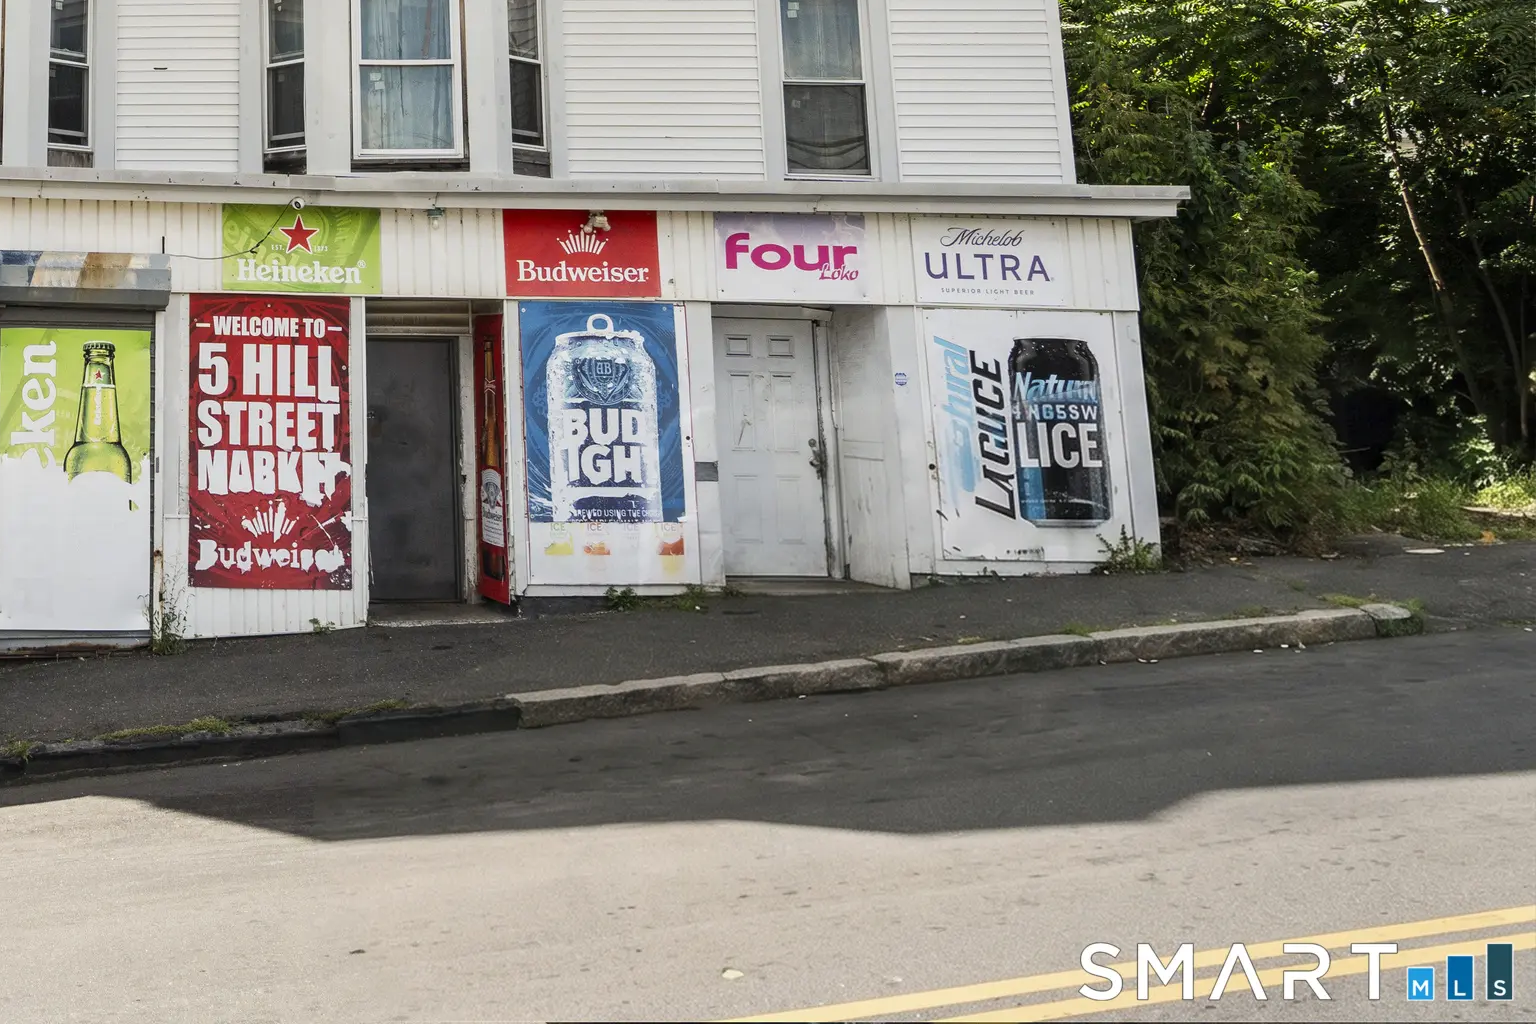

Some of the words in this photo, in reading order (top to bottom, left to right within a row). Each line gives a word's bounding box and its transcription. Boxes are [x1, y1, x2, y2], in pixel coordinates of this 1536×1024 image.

[940, 227, 1025, 247] Michelob
[725, 232, 857, 271] four
[237, 258, 362, 284] Heineken
[517, 259, 649, 283] Budweiser
[819, 263, 859, 281] Loko
[924, 252, 1051, 282] ULTRA
[213, 315, 299, 338] WELCOME
[302, 317, 326, 338] TO
[197, 342, 230, 396] 5
[242, 343, 341, 403] HILL
[197, 399, 341, 453] STREET
[564, 407, 644, 445] BUD
